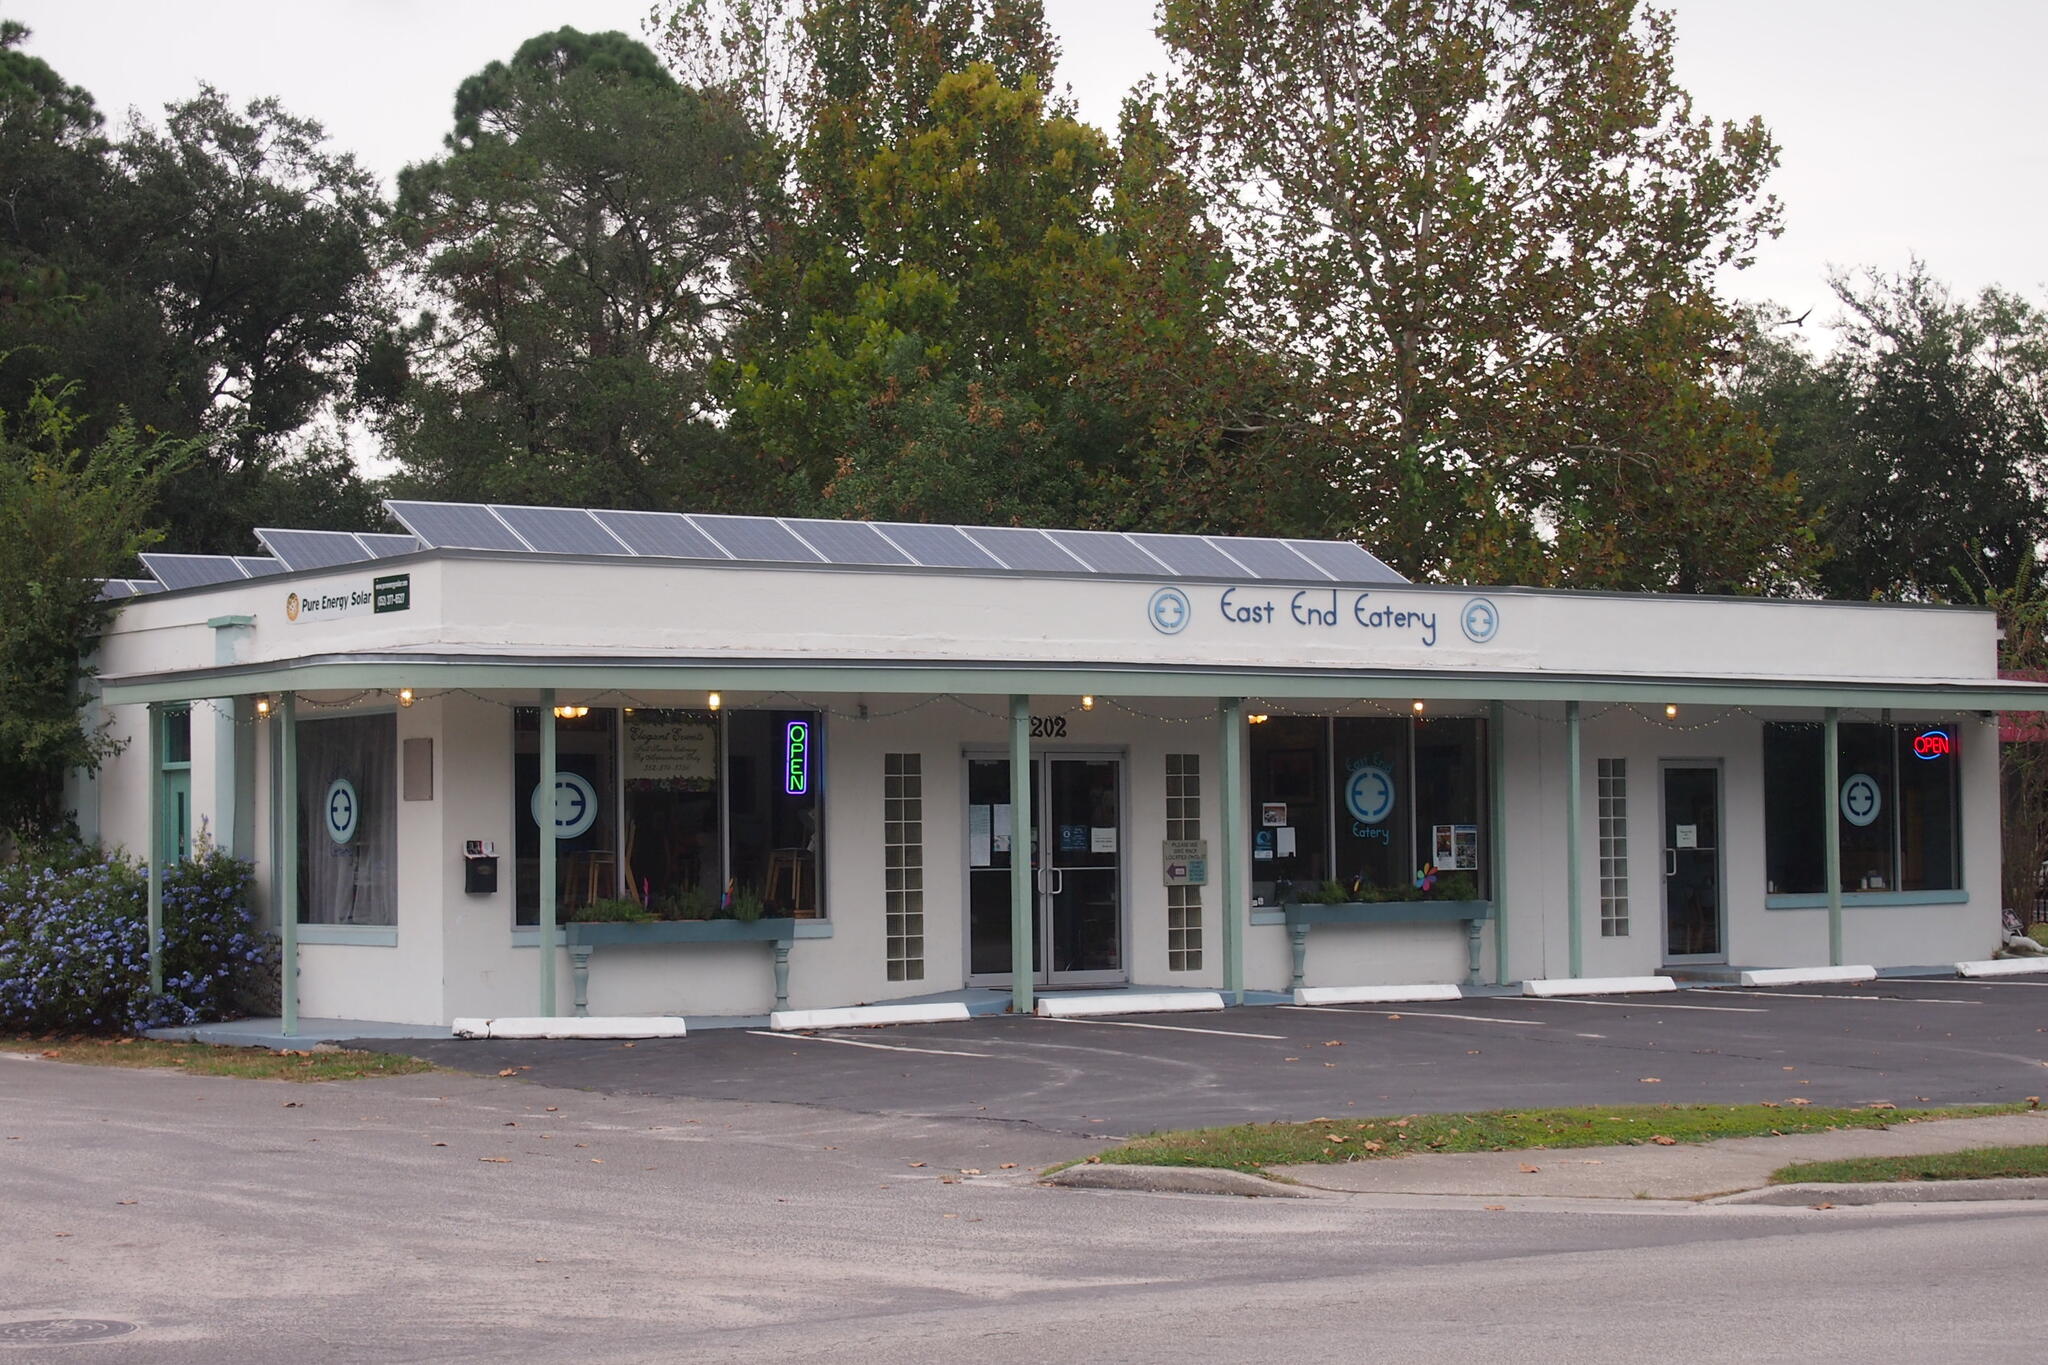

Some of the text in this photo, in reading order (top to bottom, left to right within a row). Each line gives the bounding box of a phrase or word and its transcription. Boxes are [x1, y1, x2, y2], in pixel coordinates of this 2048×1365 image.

[302, 598, 319, 612] Pure
[322, 595, 349, 610] Energy
[351, 591, 372, 606] Solar
[1220, 588, 1436, 646] East End Eatery
[1029, 715, 1067, 738] 202
[1913, 736, 1950, 755] OPEN
[789, 725, 805, 791] OPEN
[1352, 822, 1390, 845] Eatery
